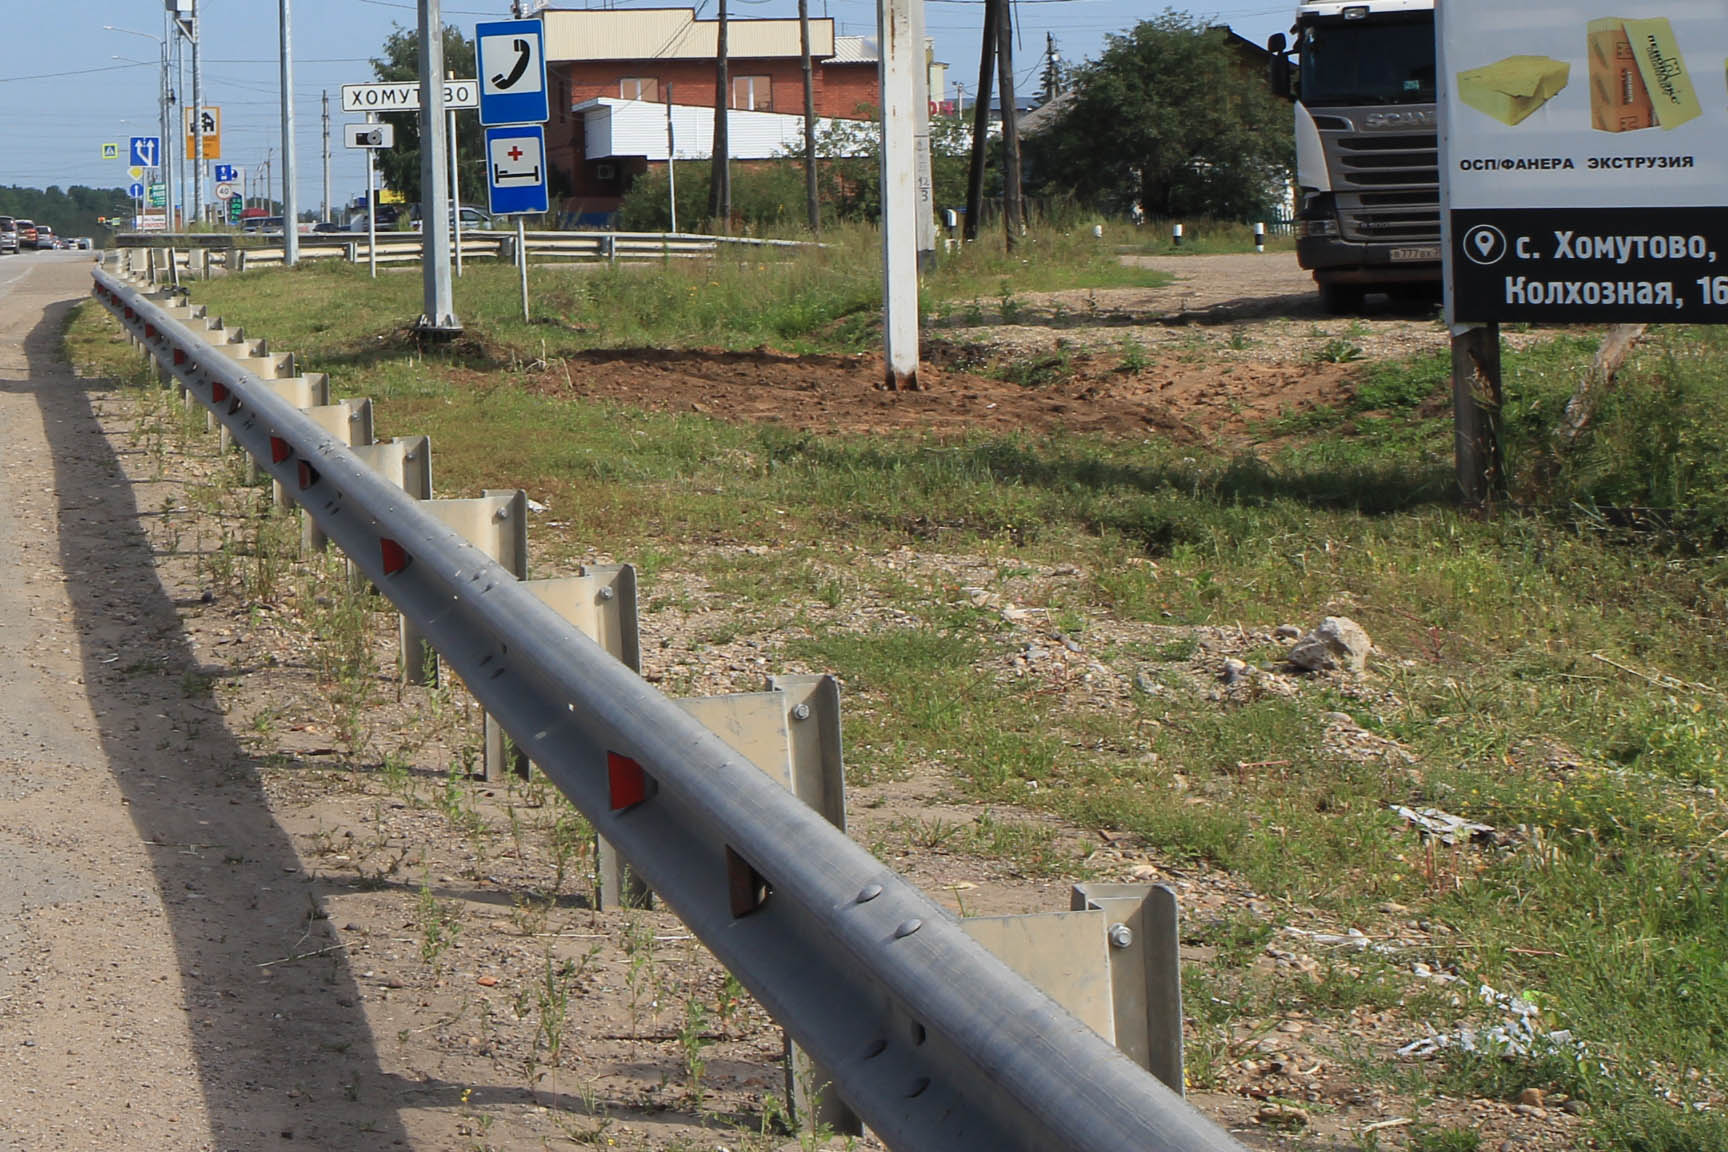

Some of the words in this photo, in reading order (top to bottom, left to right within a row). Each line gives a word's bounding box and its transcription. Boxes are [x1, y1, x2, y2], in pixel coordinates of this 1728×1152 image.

[351, 86, 469, 106] ХОМУТВО
[1459, 158, 1575, 171] ОСП/ФАНЕРА
[1587, 156, 1694, 169] ЭКСТРУЗИЯ
[1515, 237, 1540, 259] с.
[1553, 231, 1716, 264] Хомутово,
[1505, 276, 1683, 309] Колхозная,
